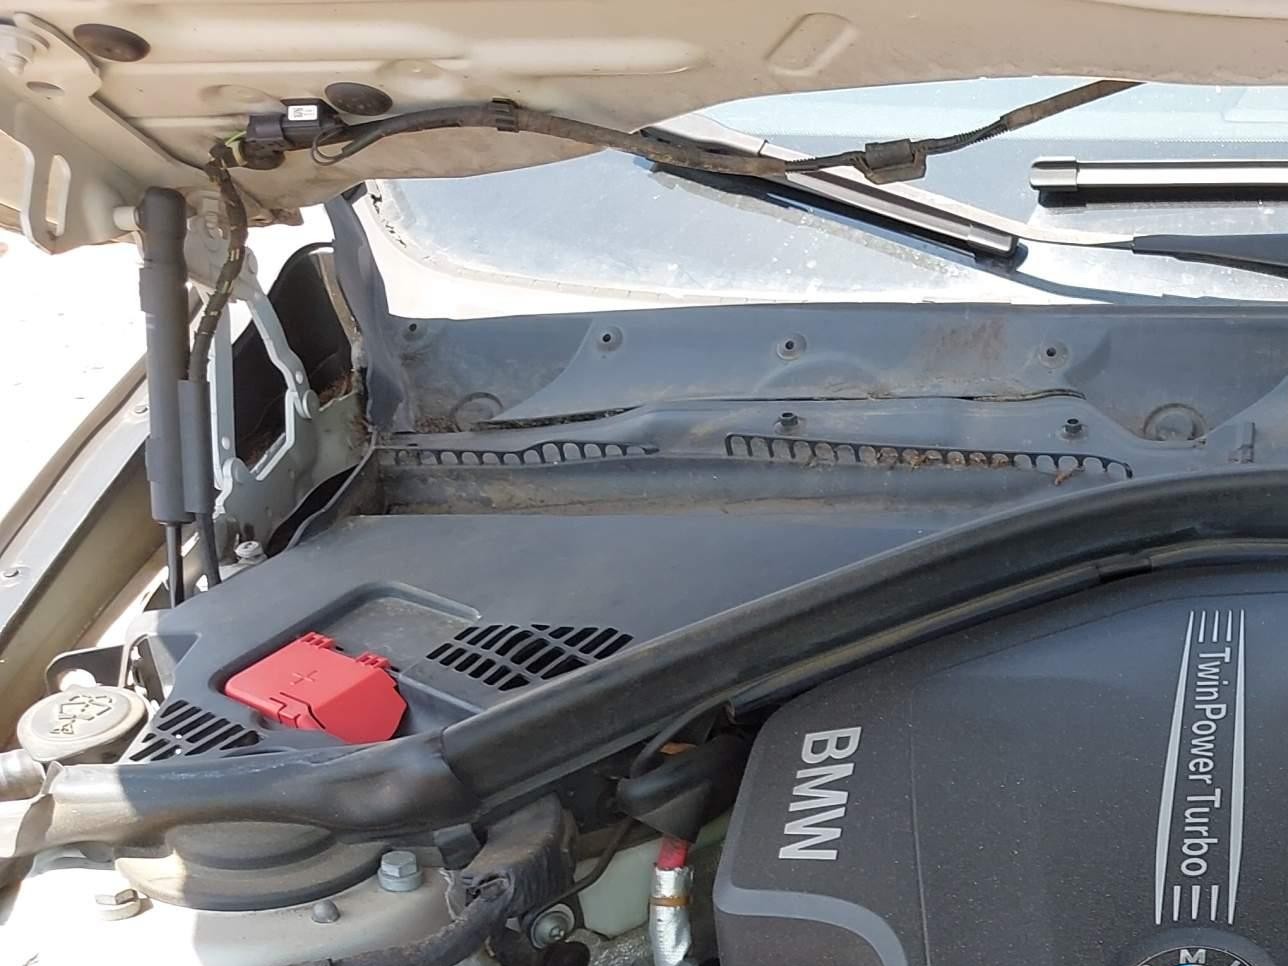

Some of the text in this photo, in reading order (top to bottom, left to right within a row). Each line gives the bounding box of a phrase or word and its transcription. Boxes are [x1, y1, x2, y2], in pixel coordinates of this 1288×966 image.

[778, 726, 862, 861] BMW
[1180, 647, 1231, 877] TwinPower Turbo
